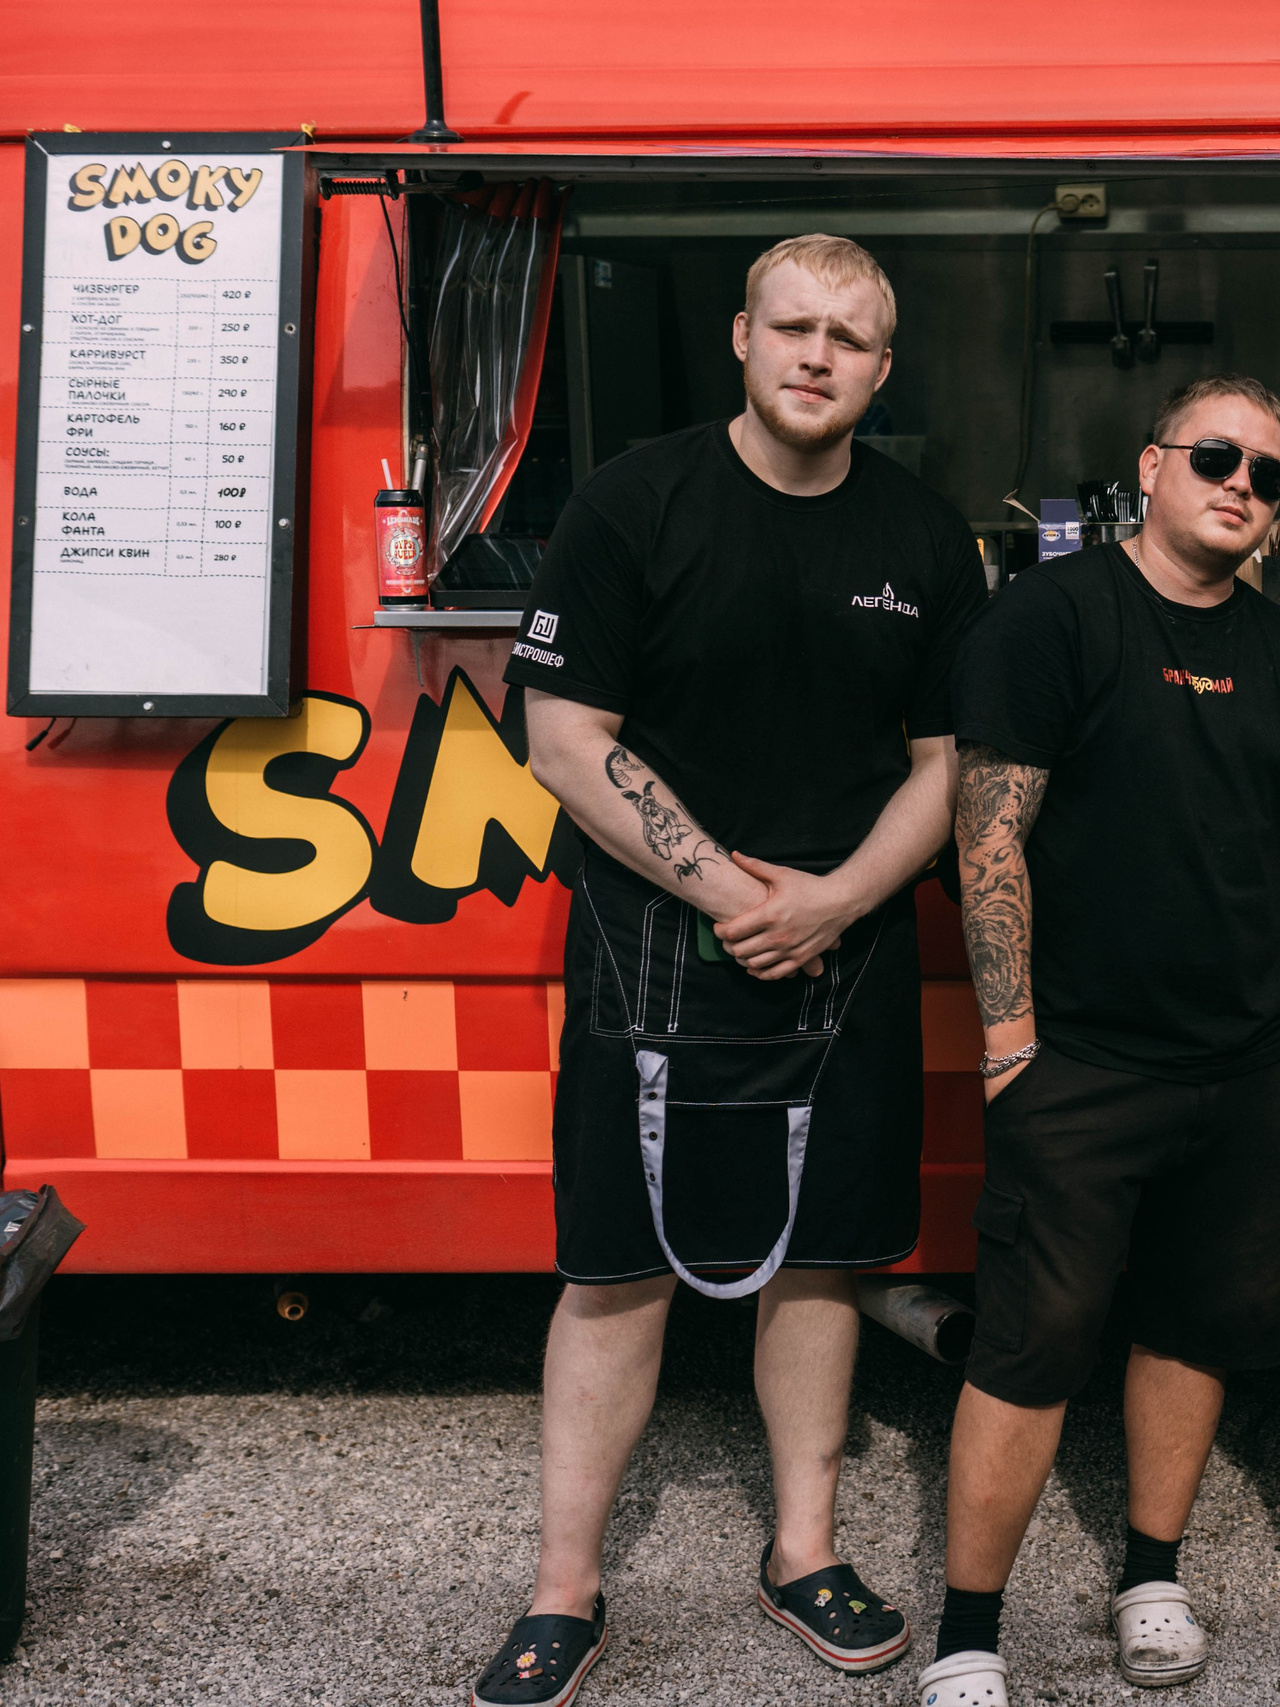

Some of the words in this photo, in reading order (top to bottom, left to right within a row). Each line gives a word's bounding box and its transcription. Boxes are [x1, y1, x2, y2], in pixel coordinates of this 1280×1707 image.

[68, 159, 263, 212] SMOKY
[104, 213, 217, 264] DOG
[73, 284, 140, 294] ЧИЗБУРГЕР
[222, 290, 242, 299] 420
[71, 314, 123, 325] ХОТ-ДОГ
[221, 324, 240, 332] 250
[70, 350, 146, 360] КАРРИВУРСТ
[220, 356, 239, 364] 350
[68, 379, 120, 388] СЫРНЫЕ
[68, 391, 126, 401] ПАЛОЧКИ
[218, 389, 238, 398] 290
[66, 414, 140, 424] КАРТОФЕЛЬ
[219, 422, 236, 431] 160
[66, 427, 93, 437] ФРИ
[66, 447, 110, 457] СОУСЫ:
[222, 455, 235, 463] 50
[64, 486, 98, 498] ВОДА
[62, 512, 96, 521] КОЛА
[386, 516, 420, 526] LEMONADE
[215, 520, 232, 528] 100
[61, 525, 105, 536] ФАНТА
[394, 539, 416, 550] GYPSY
[60, 547, 114, 558] ДЖИПСИ
[118, 548, 150, 558] КВИН
[394, 550, 416, 560] QUEEN
[852, 595, 919, 618] ЛЕГЕНДА
